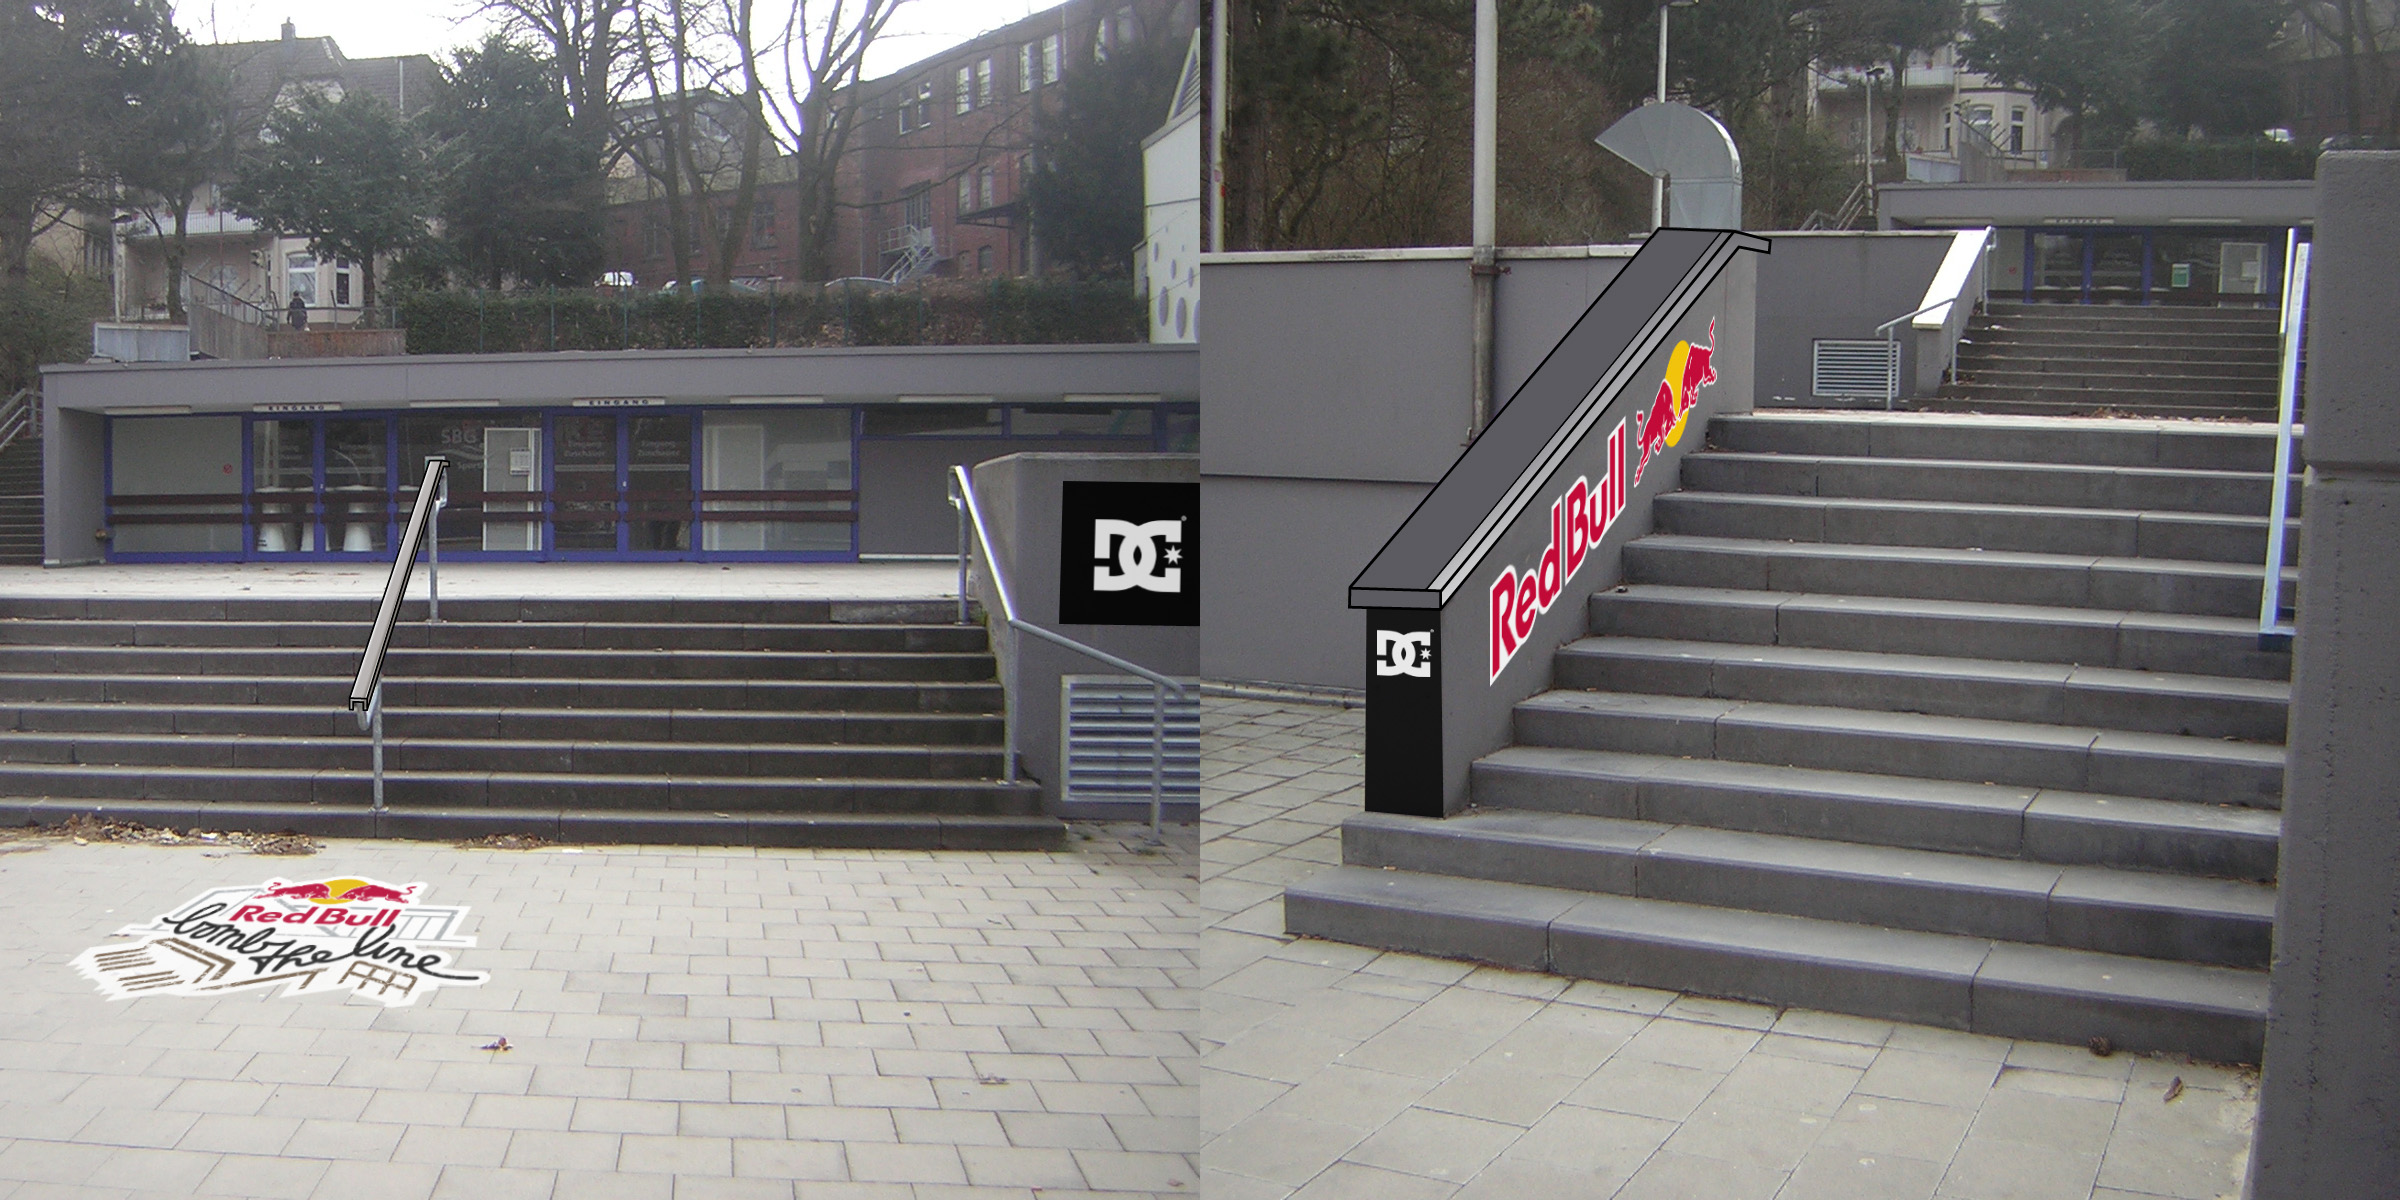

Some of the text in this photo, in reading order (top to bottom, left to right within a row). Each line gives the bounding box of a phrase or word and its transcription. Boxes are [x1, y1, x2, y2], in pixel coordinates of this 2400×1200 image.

[441, 426, 478, 444] SBG
[1490, 419, 1626, 684] Red Bull
[229, 905, 402, 928] Red Bull
